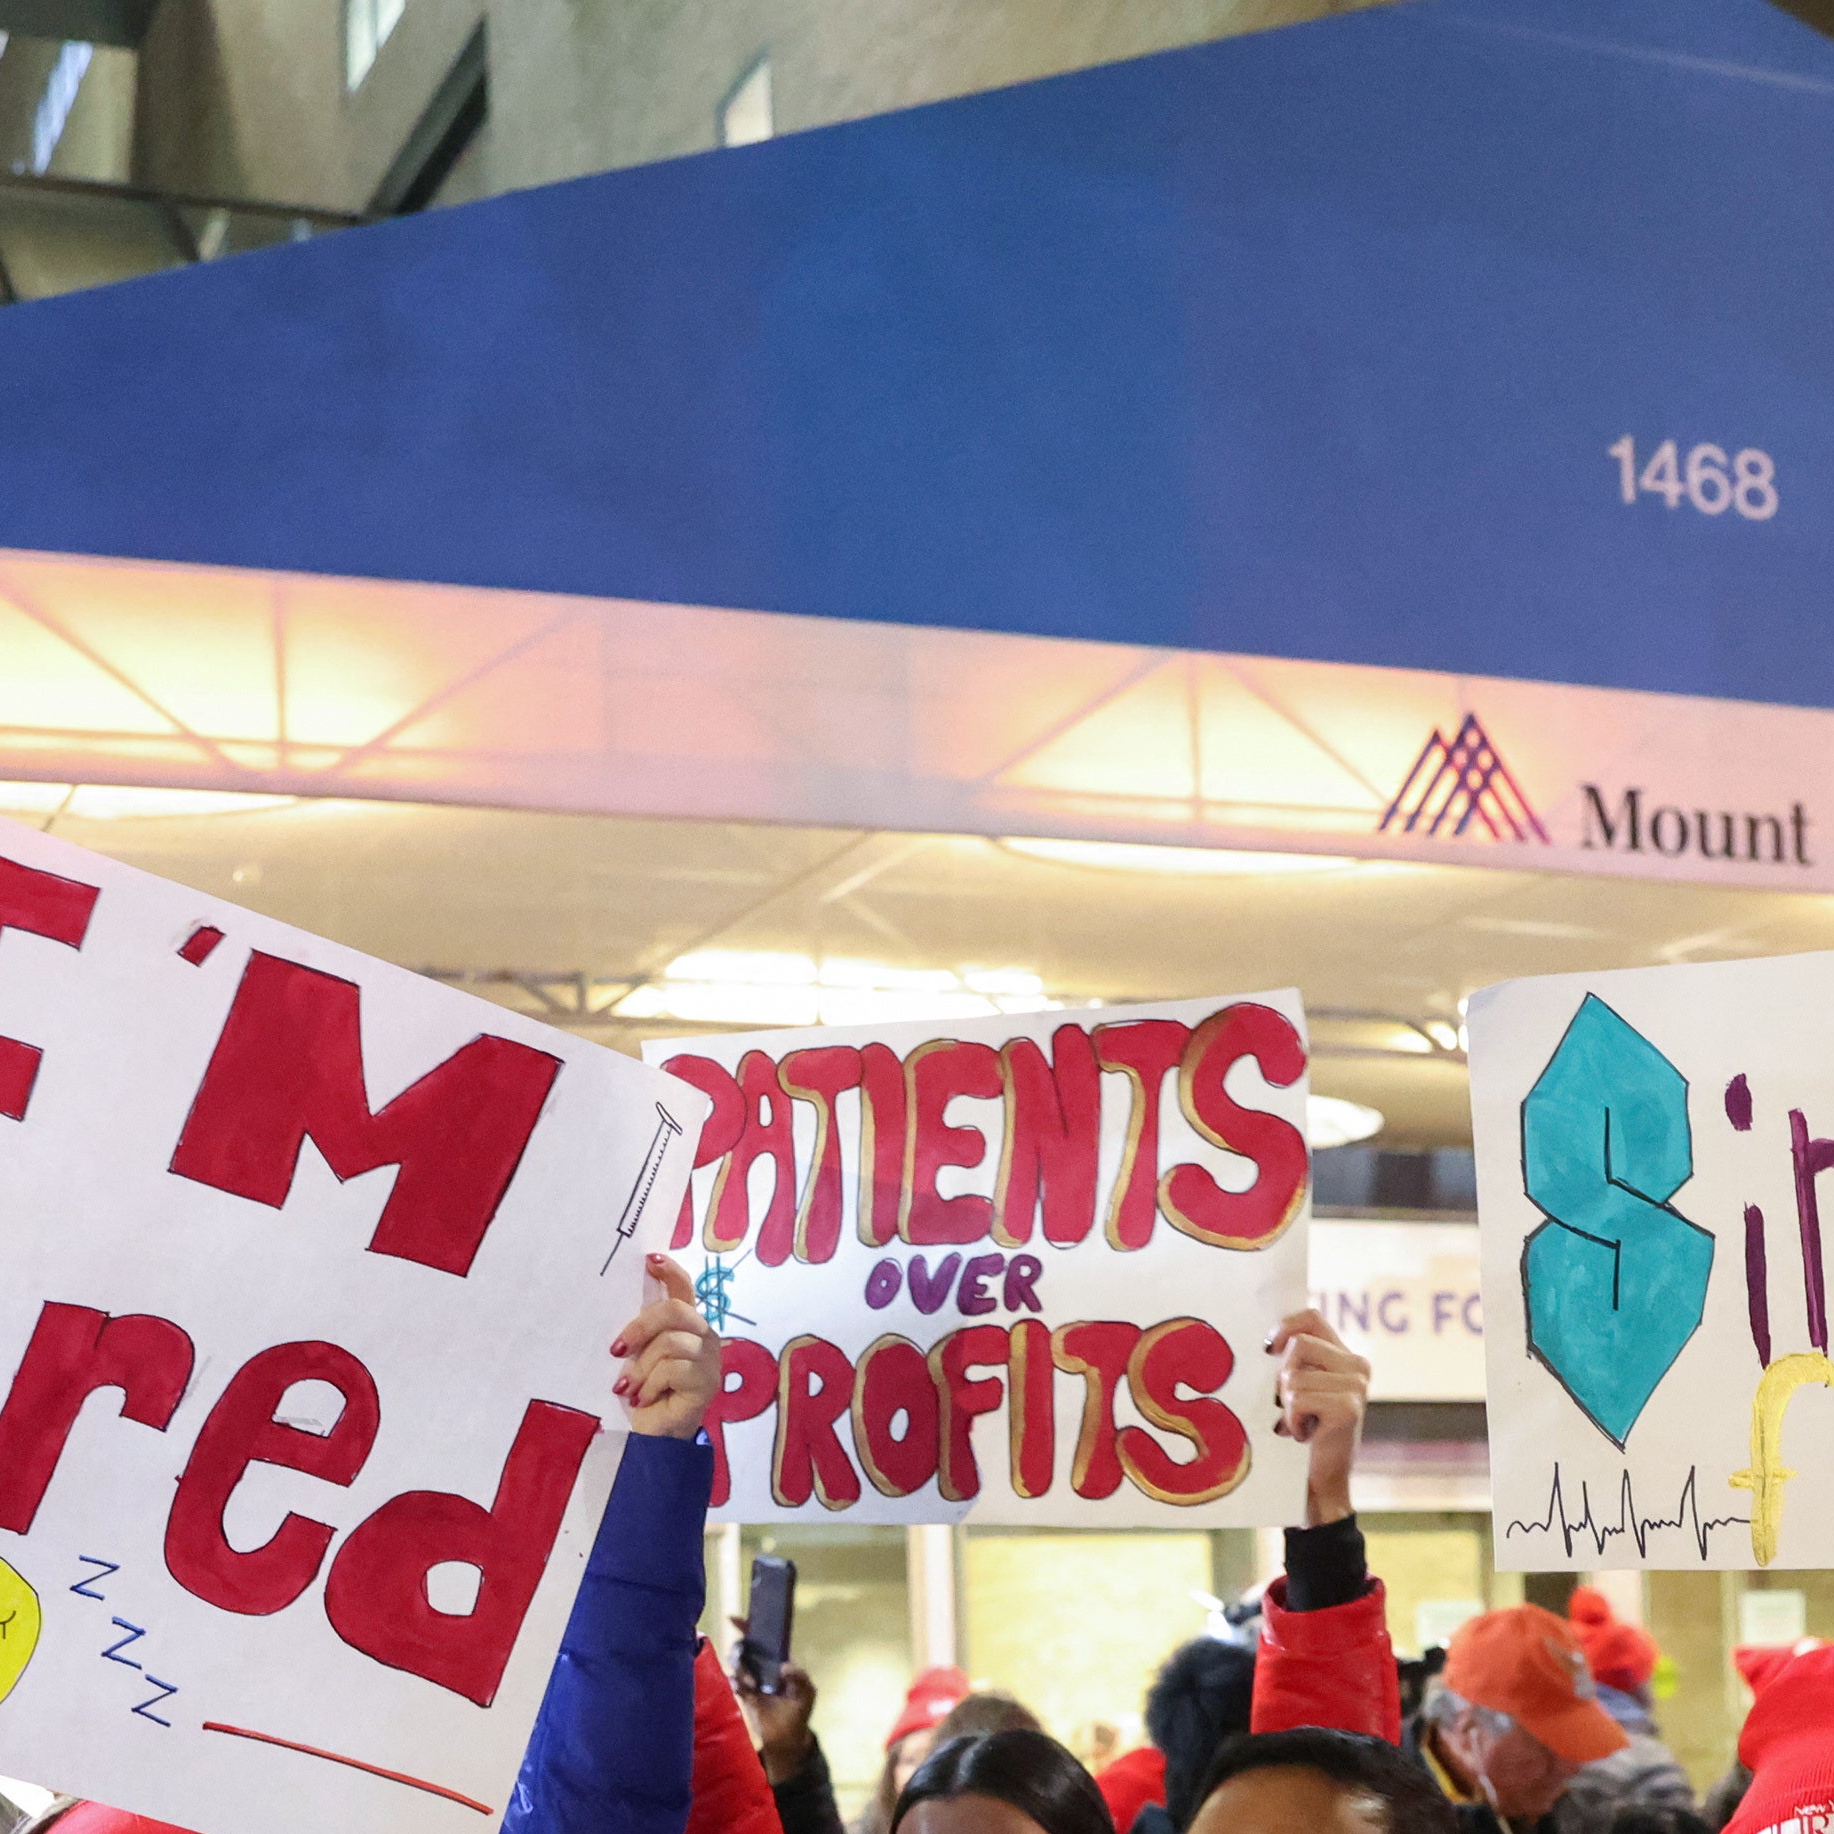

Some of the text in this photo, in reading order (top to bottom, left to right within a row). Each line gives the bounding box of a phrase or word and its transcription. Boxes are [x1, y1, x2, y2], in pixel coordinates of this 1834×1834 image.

[1608, 433, 1779, 521] 1468
[1579, 782, 1813, 868] Mount
[659, 1001, 1310, 1267] PATIENTS
[865, 1252, 1044, 1315] OVER
[707, 1316, 1252, 1511] PROFITS
[1794, 1804, 1827, 1816] New
